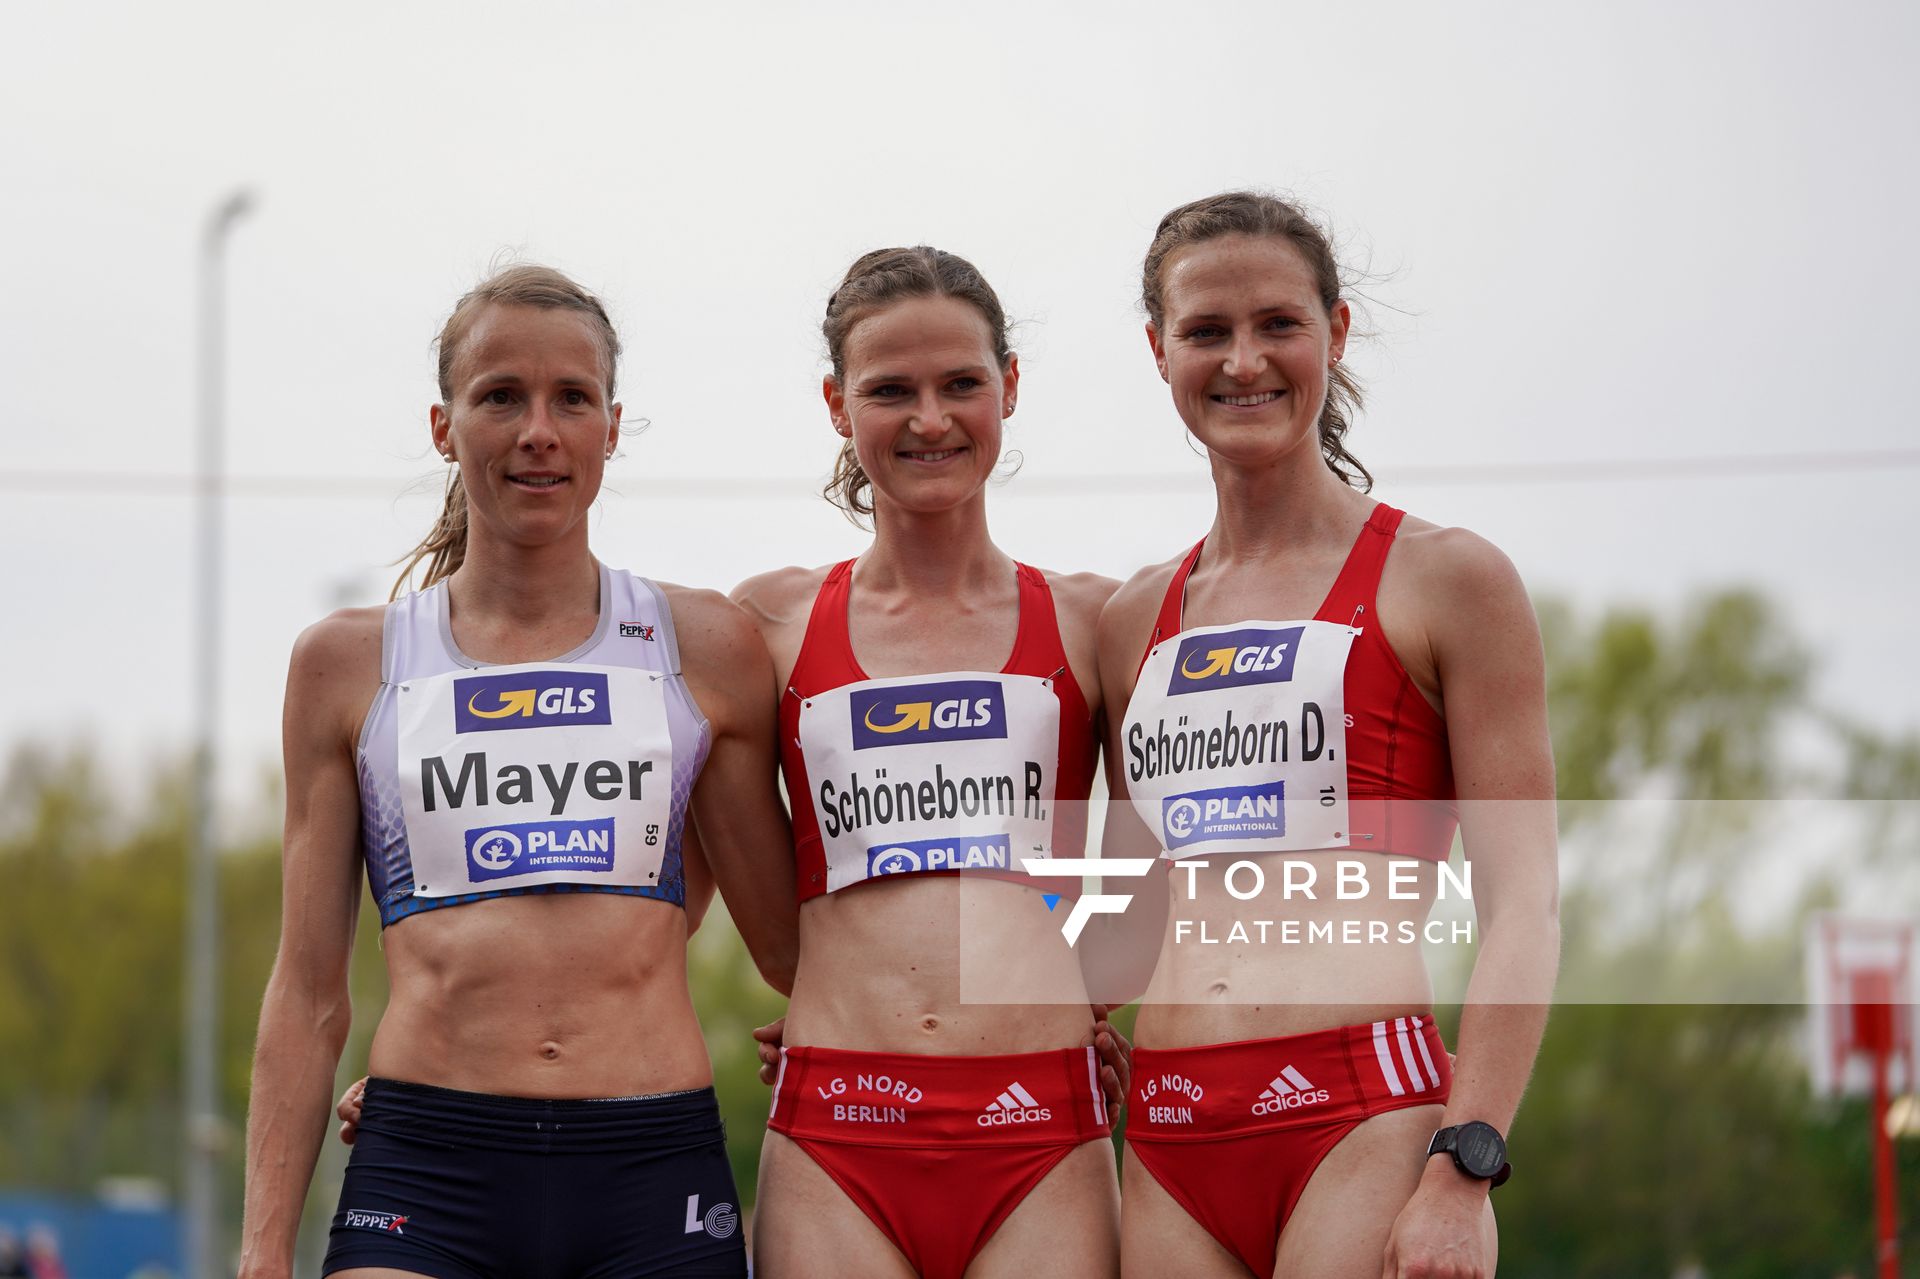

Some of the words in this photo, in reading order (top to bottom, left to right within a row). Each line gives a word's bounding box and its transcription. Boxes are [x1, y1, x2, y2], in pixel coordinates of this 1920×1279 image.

[1233, 643, 1289, 673] GLS
[538, 687, 596, 715] GLS
[933, 698, 991, 729] GLS
[1129, 710, 1288, 782] Schöneborn
[1301, 702, 1335, 762] D.
[421, 752, 653, 815] Mayer
[1320, 785, 1335, 807] 10
[821, 764, 1015, 838] Schöneborn
[1023, 761, 1046, 821] R.
[1205, 794, 1278, 821] PLAN
[528, 829, 609, 853] PLAN
[645, 824, 658, 846] 59
[1204, 822, 1278, 833] INTERNATIONAL
[529, 855, 608, 865] INTERNATIONAL
[927, 845, 1006, 869] PLAN
[817, 1077, 847, 1100] LG
[857, 1074, 923, 1103] NORD
[1140, 1079, 1157, 1102] LG
[1162, 1074, 1204, 1102] NORD
[834, 1104, 906, 1124] BERLIN
[977, 1103, 1052, 1127] adidas
[1149, 1106, 1193, 1124] BERLIN
[1251, 1088, 1330, 1116] adidas
[345, 1211, 407, 1234] PEPPEX
[685, 1194, 738, 1239] LG
